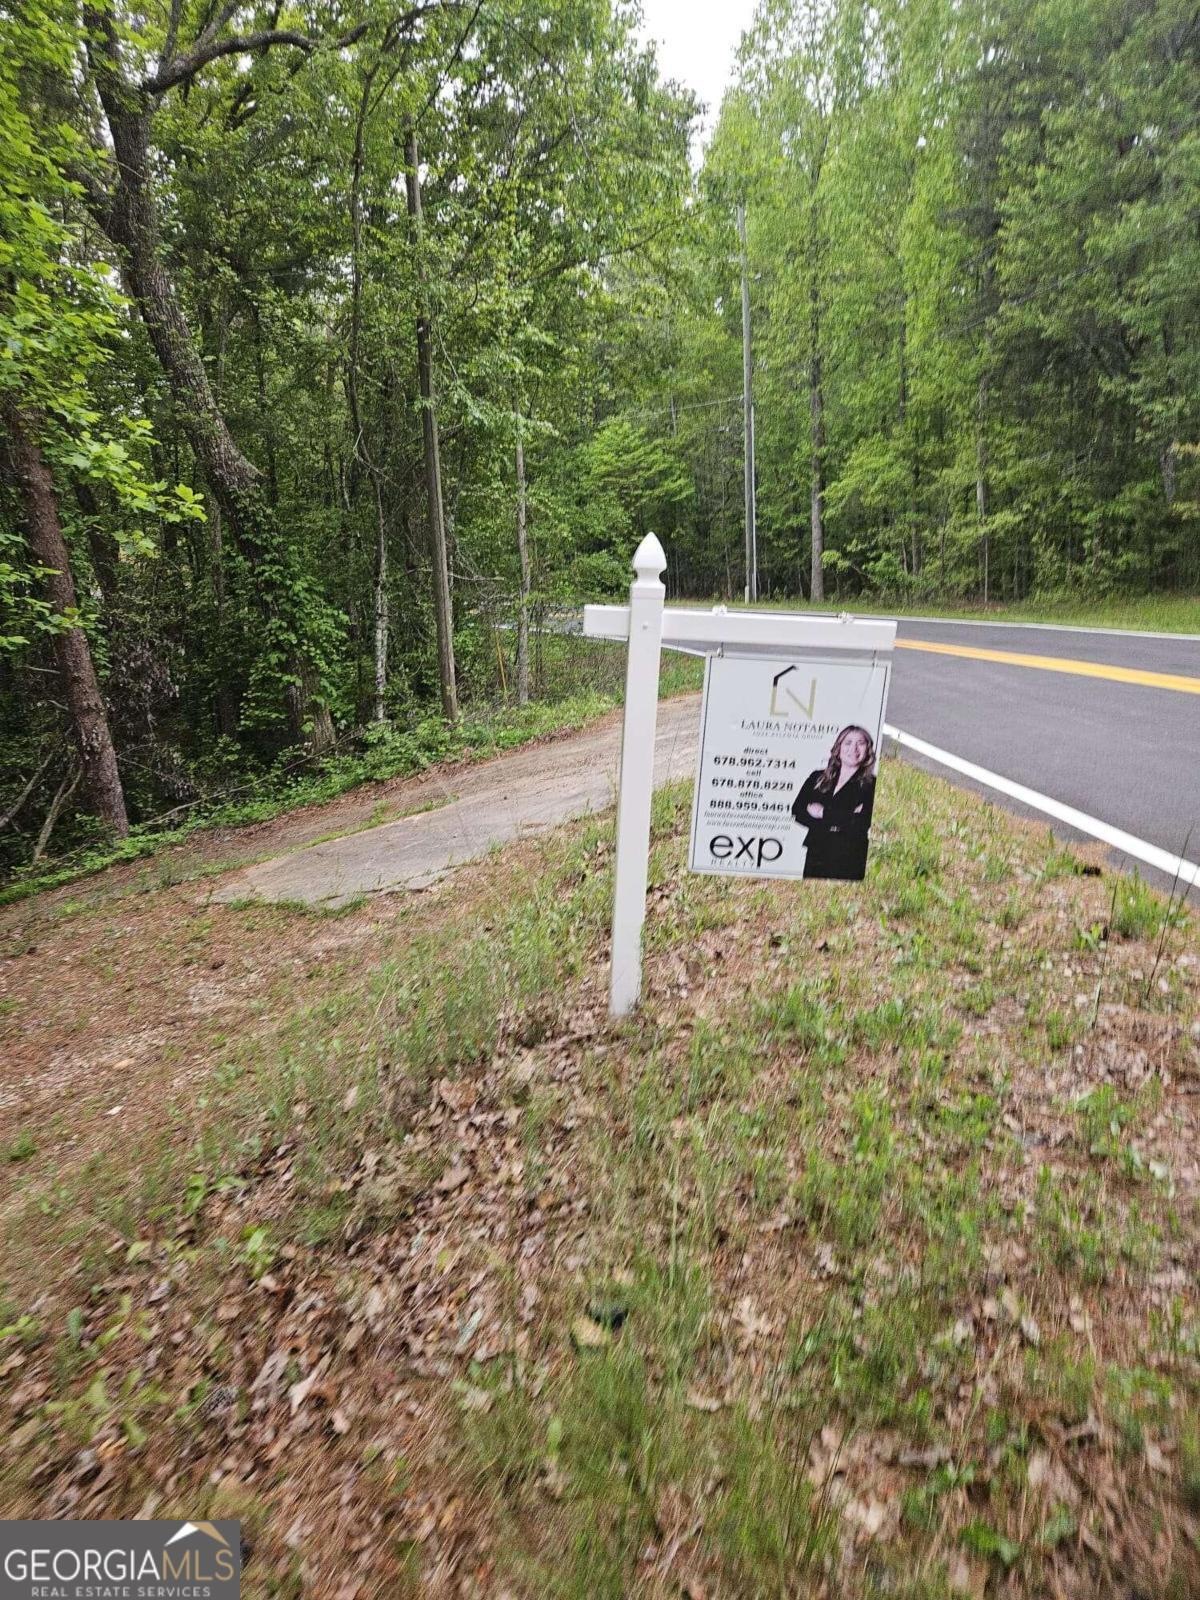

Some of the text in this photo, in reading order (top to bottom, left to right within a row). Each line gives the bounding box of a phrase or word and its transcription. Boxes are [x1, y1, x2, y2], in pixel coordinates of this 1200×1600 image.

[741, 719, 780, 731] LAURA
[743, 746, 768, 755] direct
[713, 756, 796, 769] 678.962.7314
[740, 791, 763, 799] office
[709, 835, 783, 868] exp
